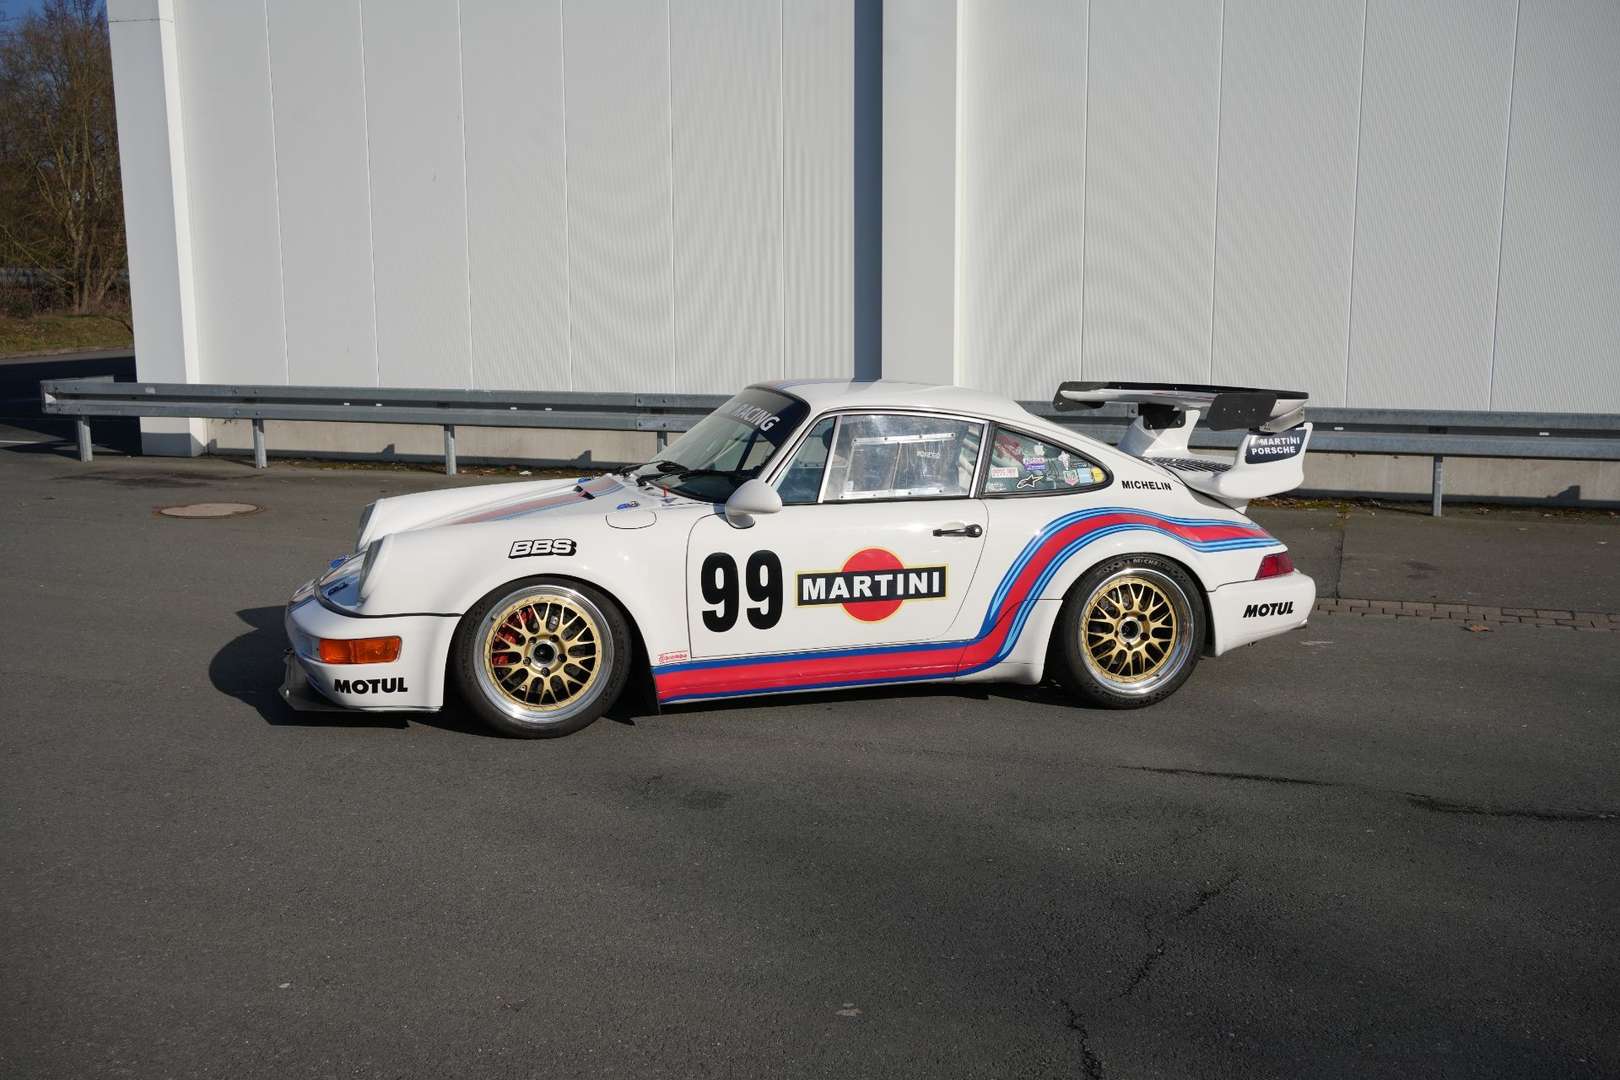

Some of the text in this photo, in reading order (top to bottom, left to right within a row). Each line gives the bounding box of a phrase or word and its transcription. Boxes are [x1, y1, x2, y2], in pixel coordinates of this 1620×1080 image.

[1259, 436, 1300, 446] MARTINI
[1251, 446, 1297, 455] PORSCHE
[1121, 480, 1172, 490] MICHELIN
[508, 538, 577, 559] BBS
[701, 550, 783, 632] 99
[802, 571, 940, 600] MARTINI
[1242, 601, 1294, 618] MOTUL
[334, 677, 408, 694] MOTUL
